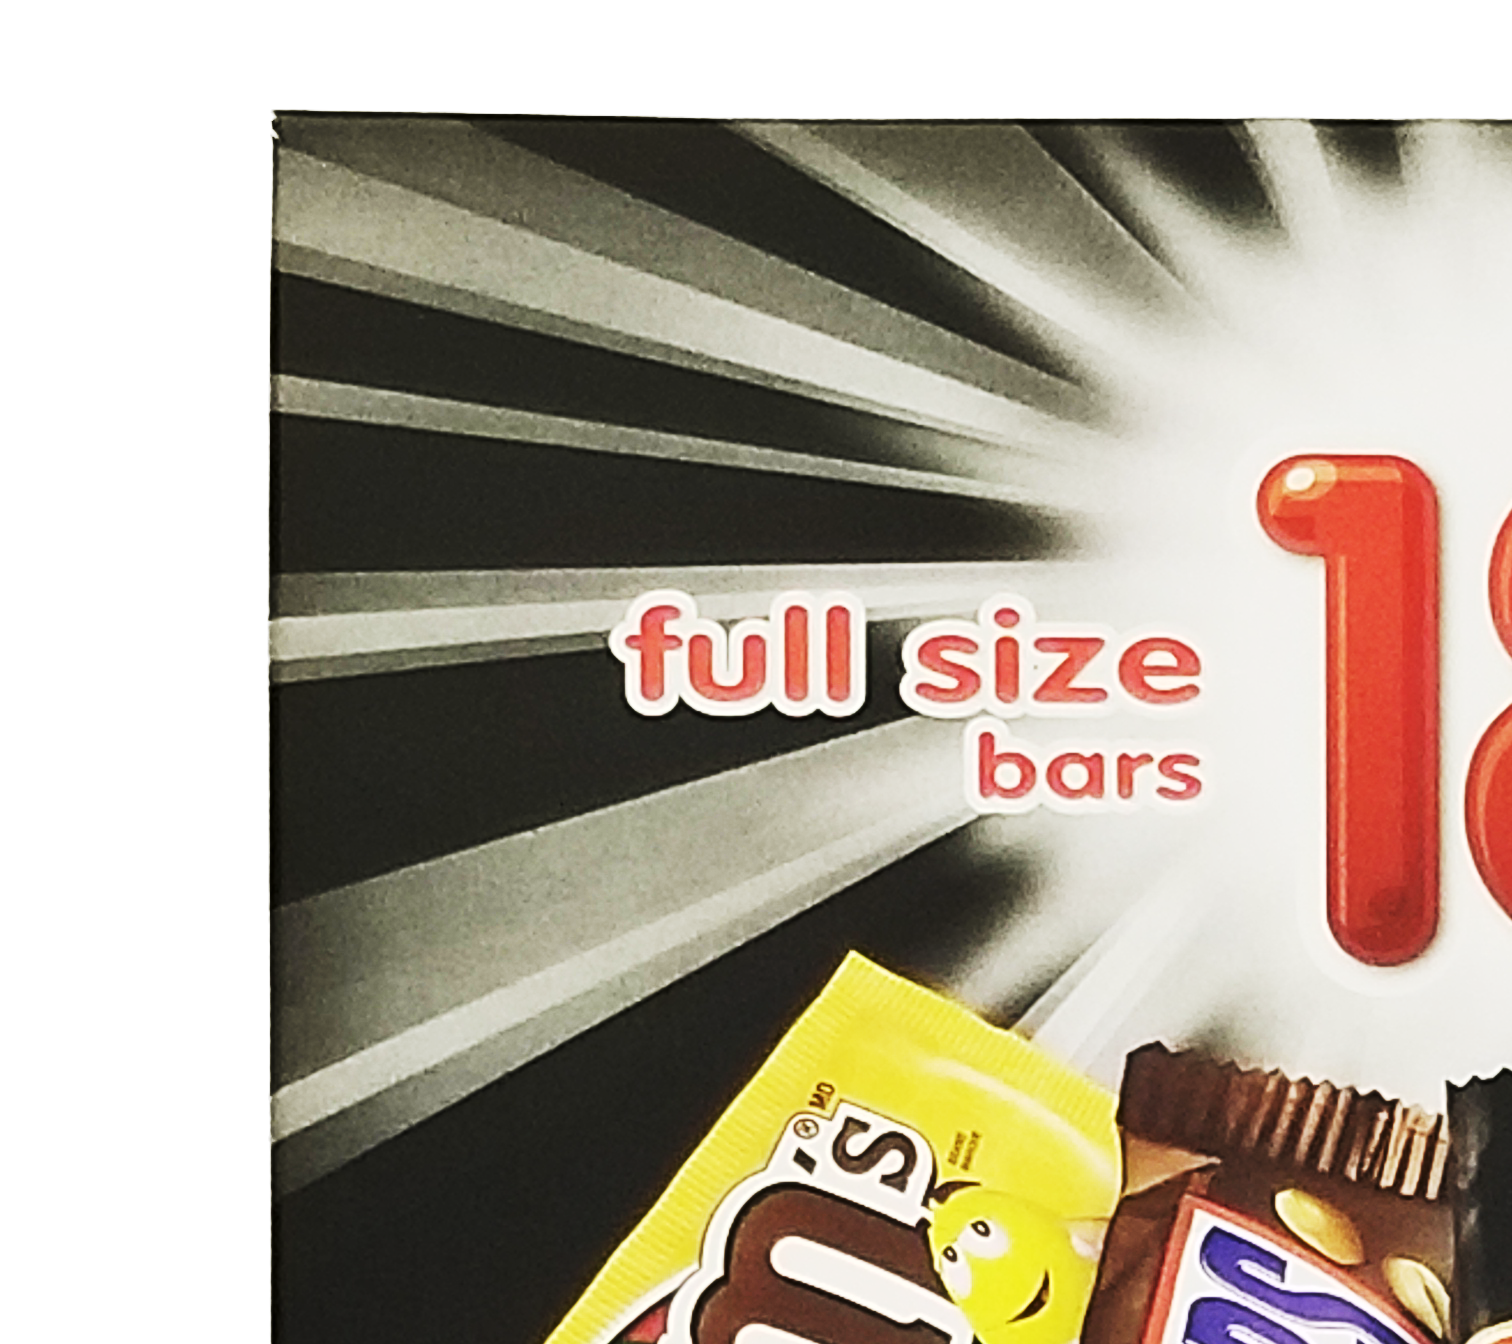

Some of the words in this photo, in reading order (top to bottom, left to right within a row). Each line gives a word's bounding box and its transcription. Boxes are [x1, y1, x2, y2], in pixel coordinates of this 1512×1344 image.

[626, 605, 851, 702] full
[916, 608, 1201, 704] size
[978, 731, 1203, 801] bars
